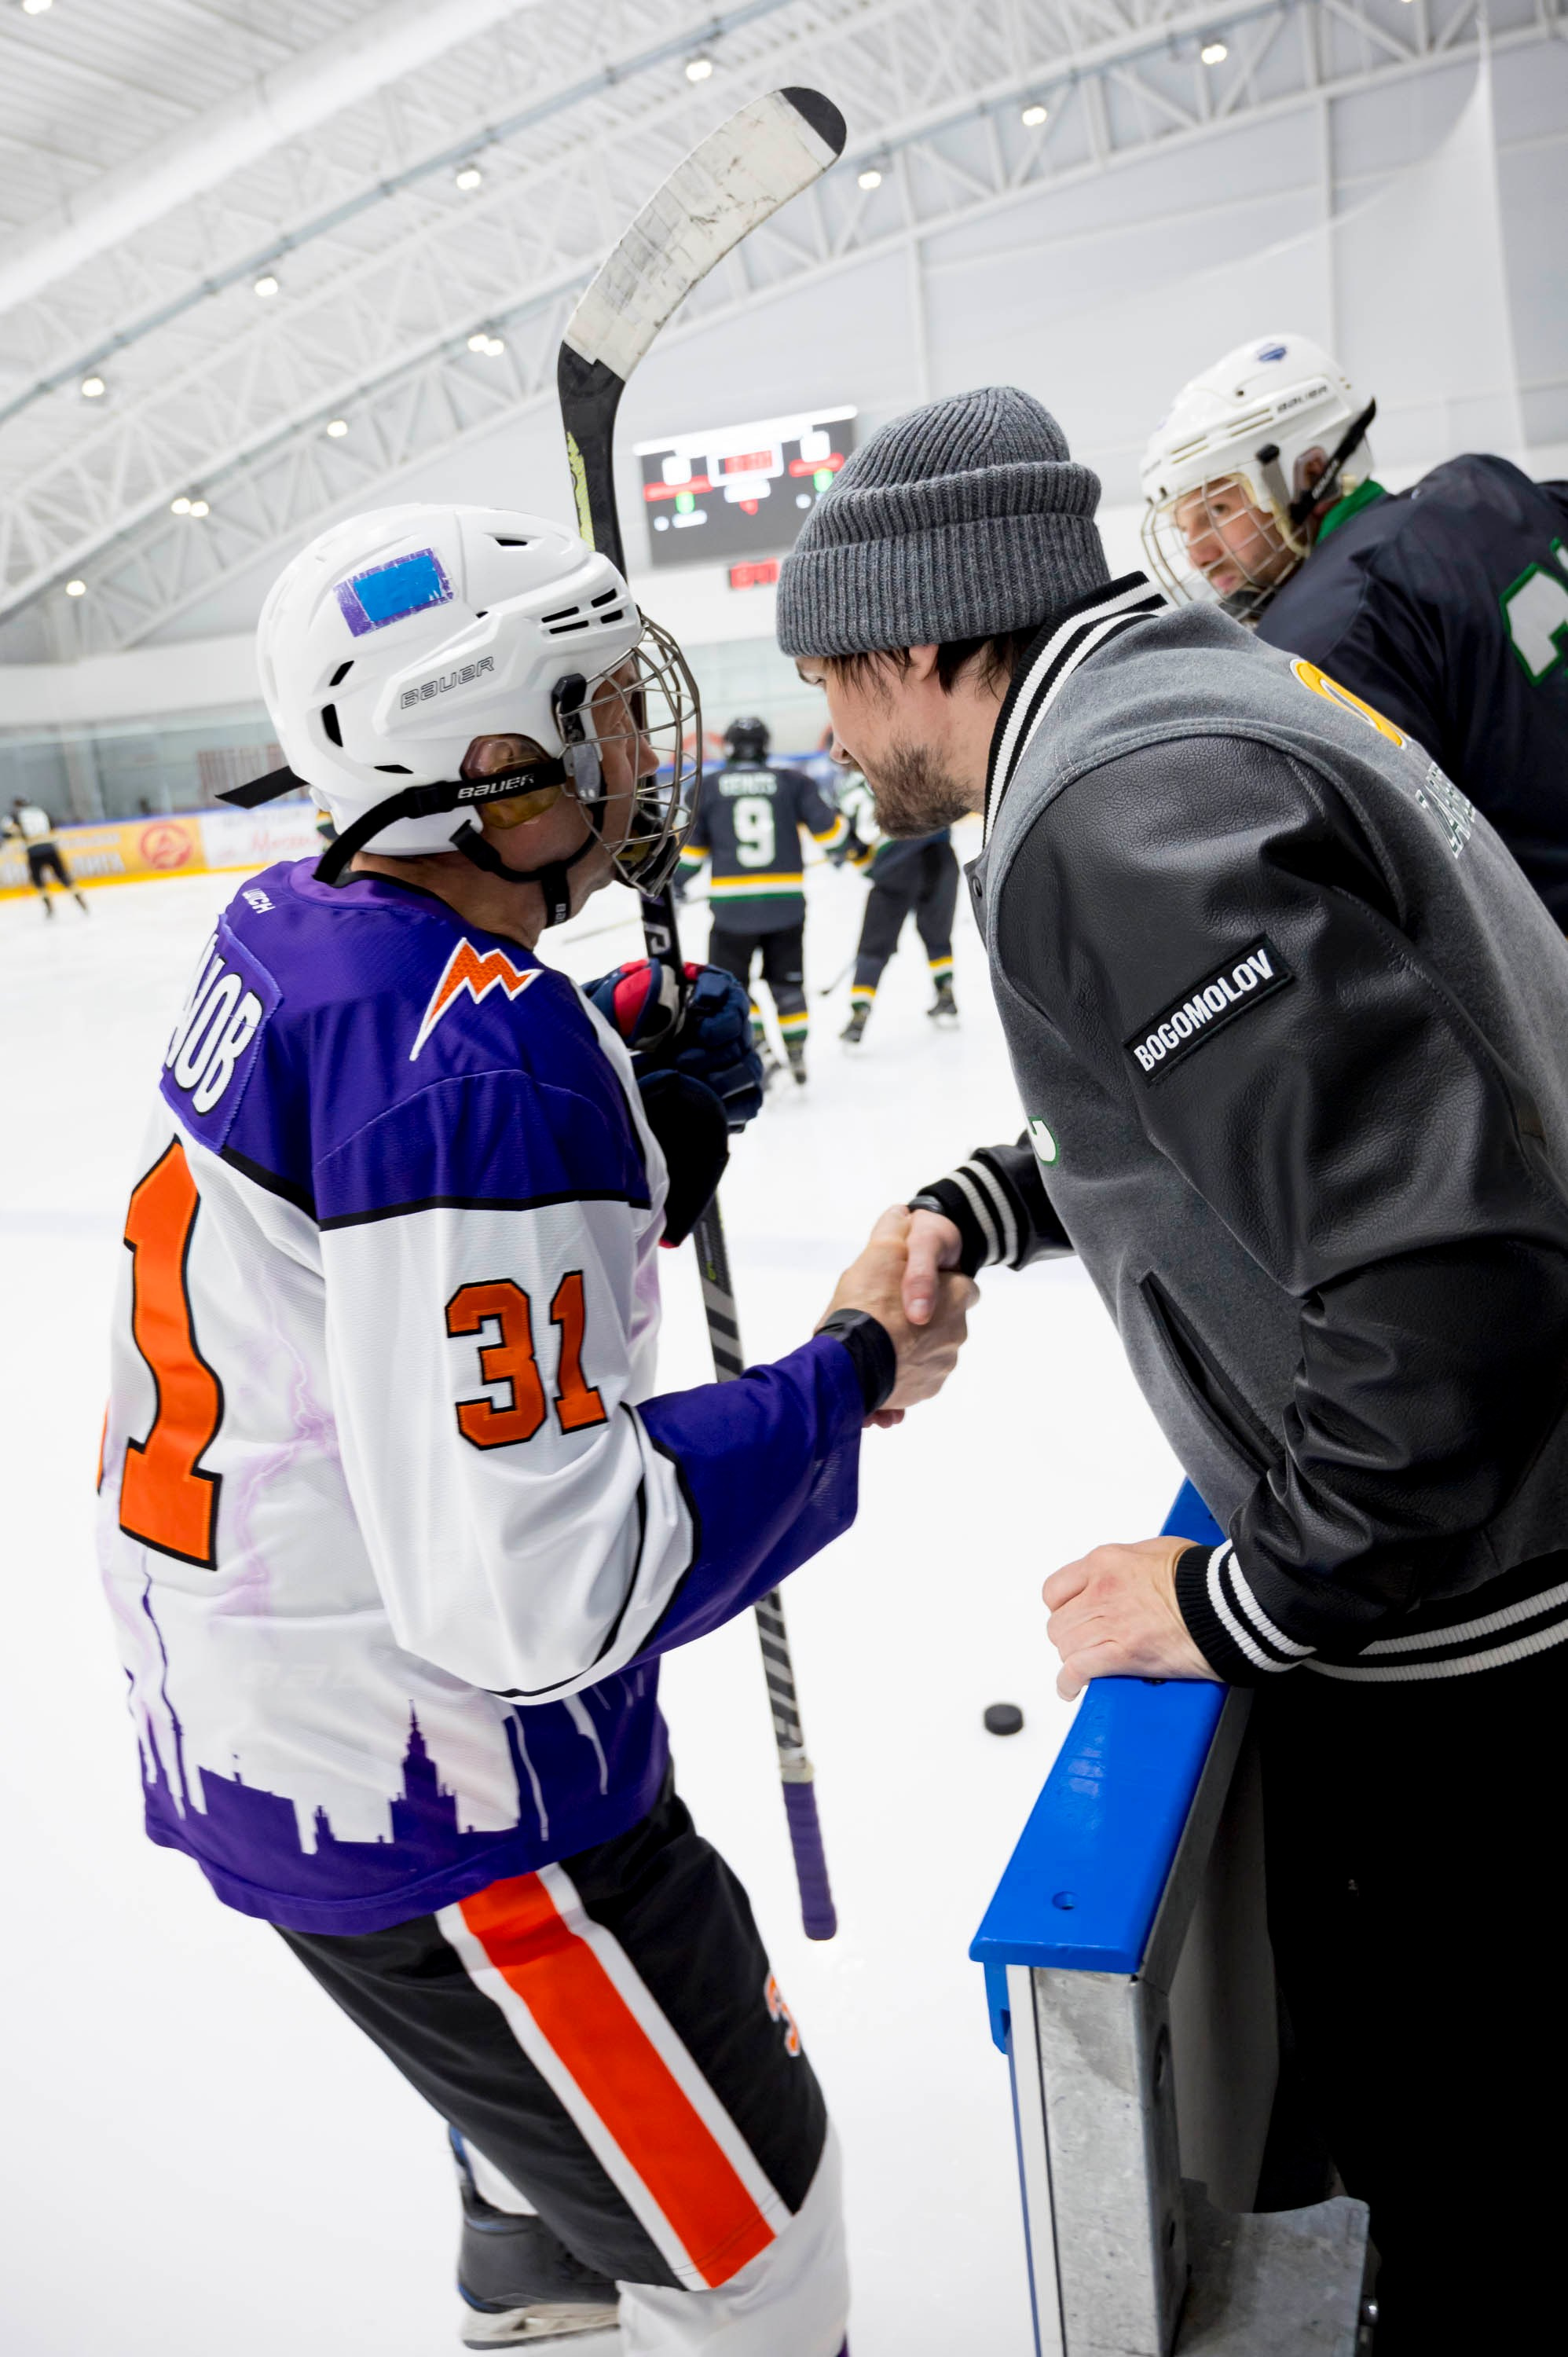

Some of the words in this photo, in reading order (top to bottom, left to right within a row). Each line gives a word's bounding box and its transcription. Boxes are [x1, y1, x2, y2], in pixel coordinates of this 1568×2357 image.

[401, 655, 495, 709] BAUER
[733, 796, 776, 869] 9
[1133, 948, 1275, 1072] BOGOMOLOV
[97, 1131, 225, 1571] 1
[445, 1269, 610, 1452] 31
